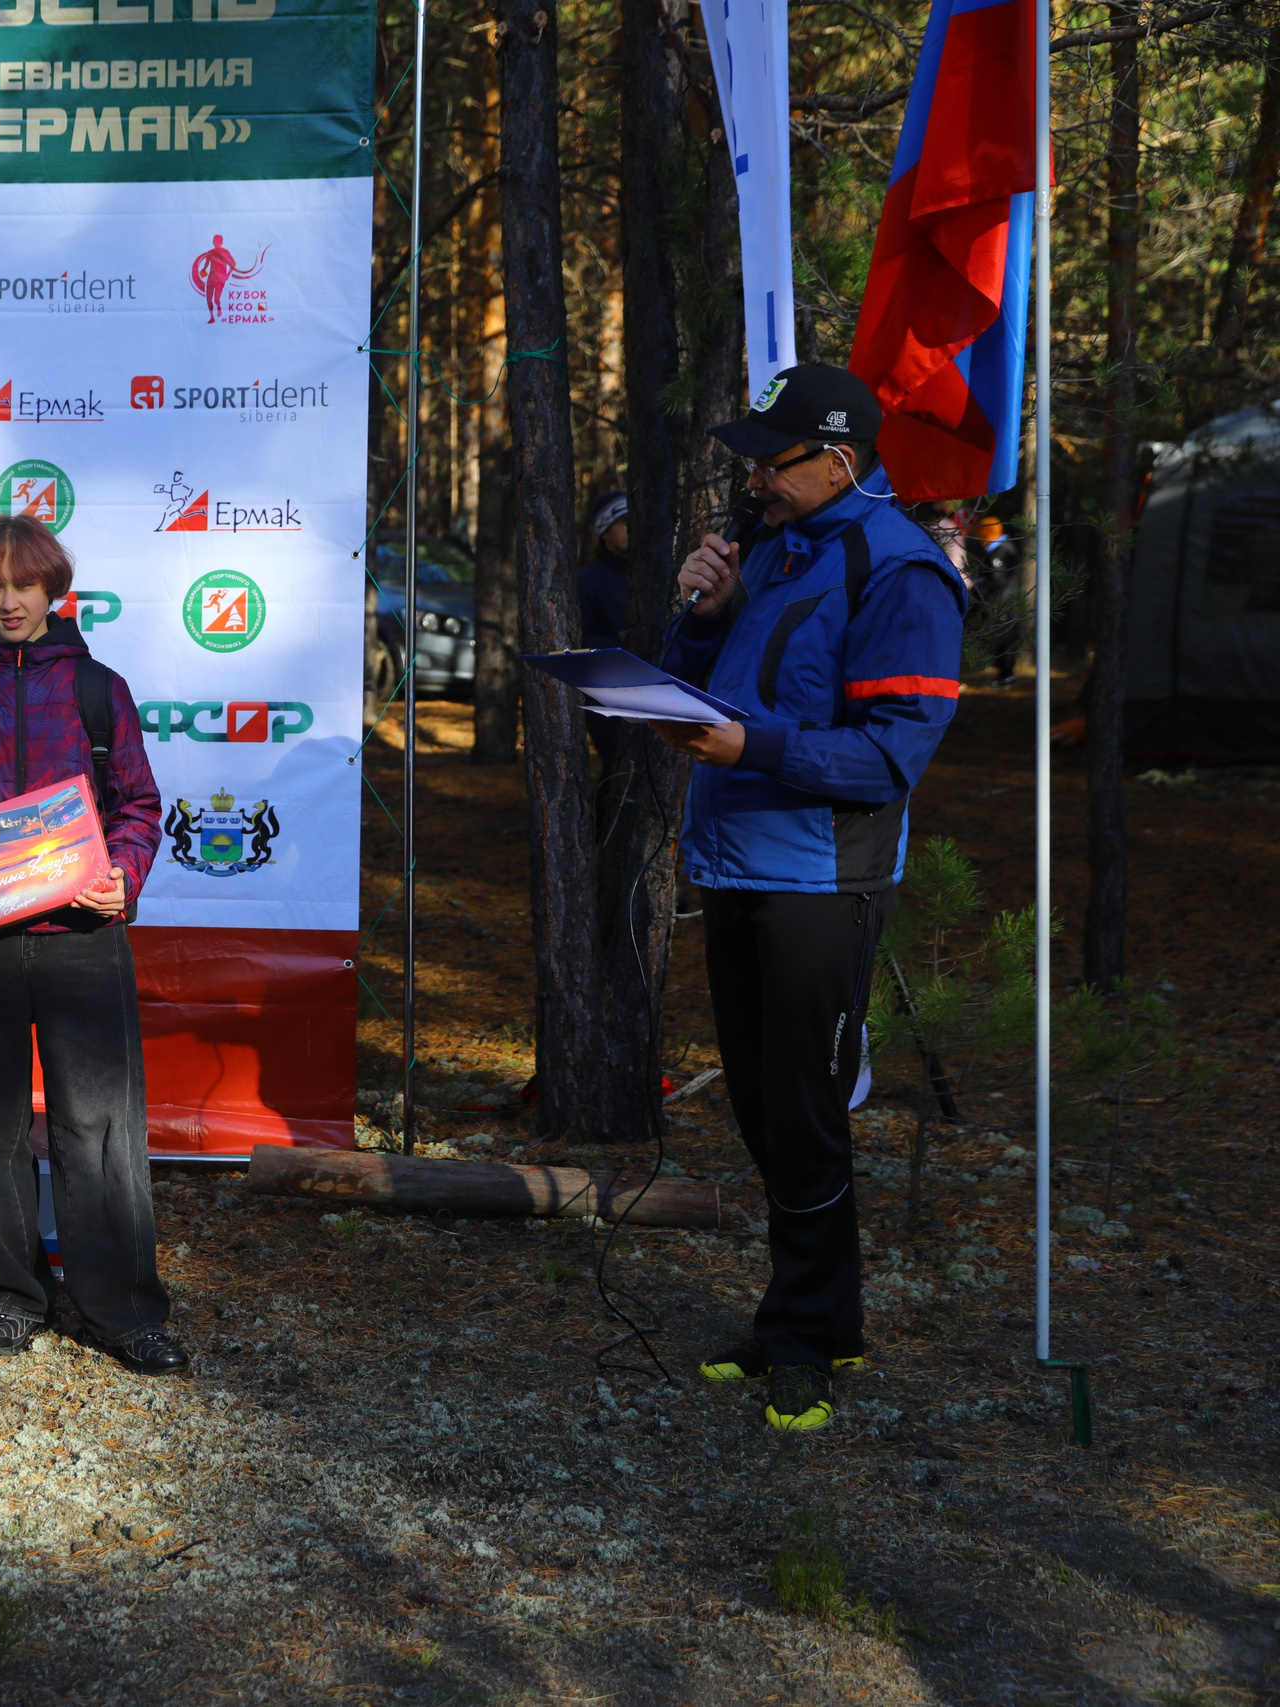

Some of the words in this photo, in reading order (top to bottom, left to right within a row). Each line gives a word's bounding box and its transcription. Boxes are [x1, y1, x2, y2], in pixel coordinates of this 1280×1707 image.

[228, 290, 267, 300] КУБОК
[48, 302, 105, 314] siberia
[228, 303, 253, 312] КСО
[173, 379, 329, 409] SPORTident
[19, 389, 103, 423] Ермак
[239, 410, 297, 422] siberia
[826, 411, 847, 427] 45
[215, 499, 301, 533] Ермак
